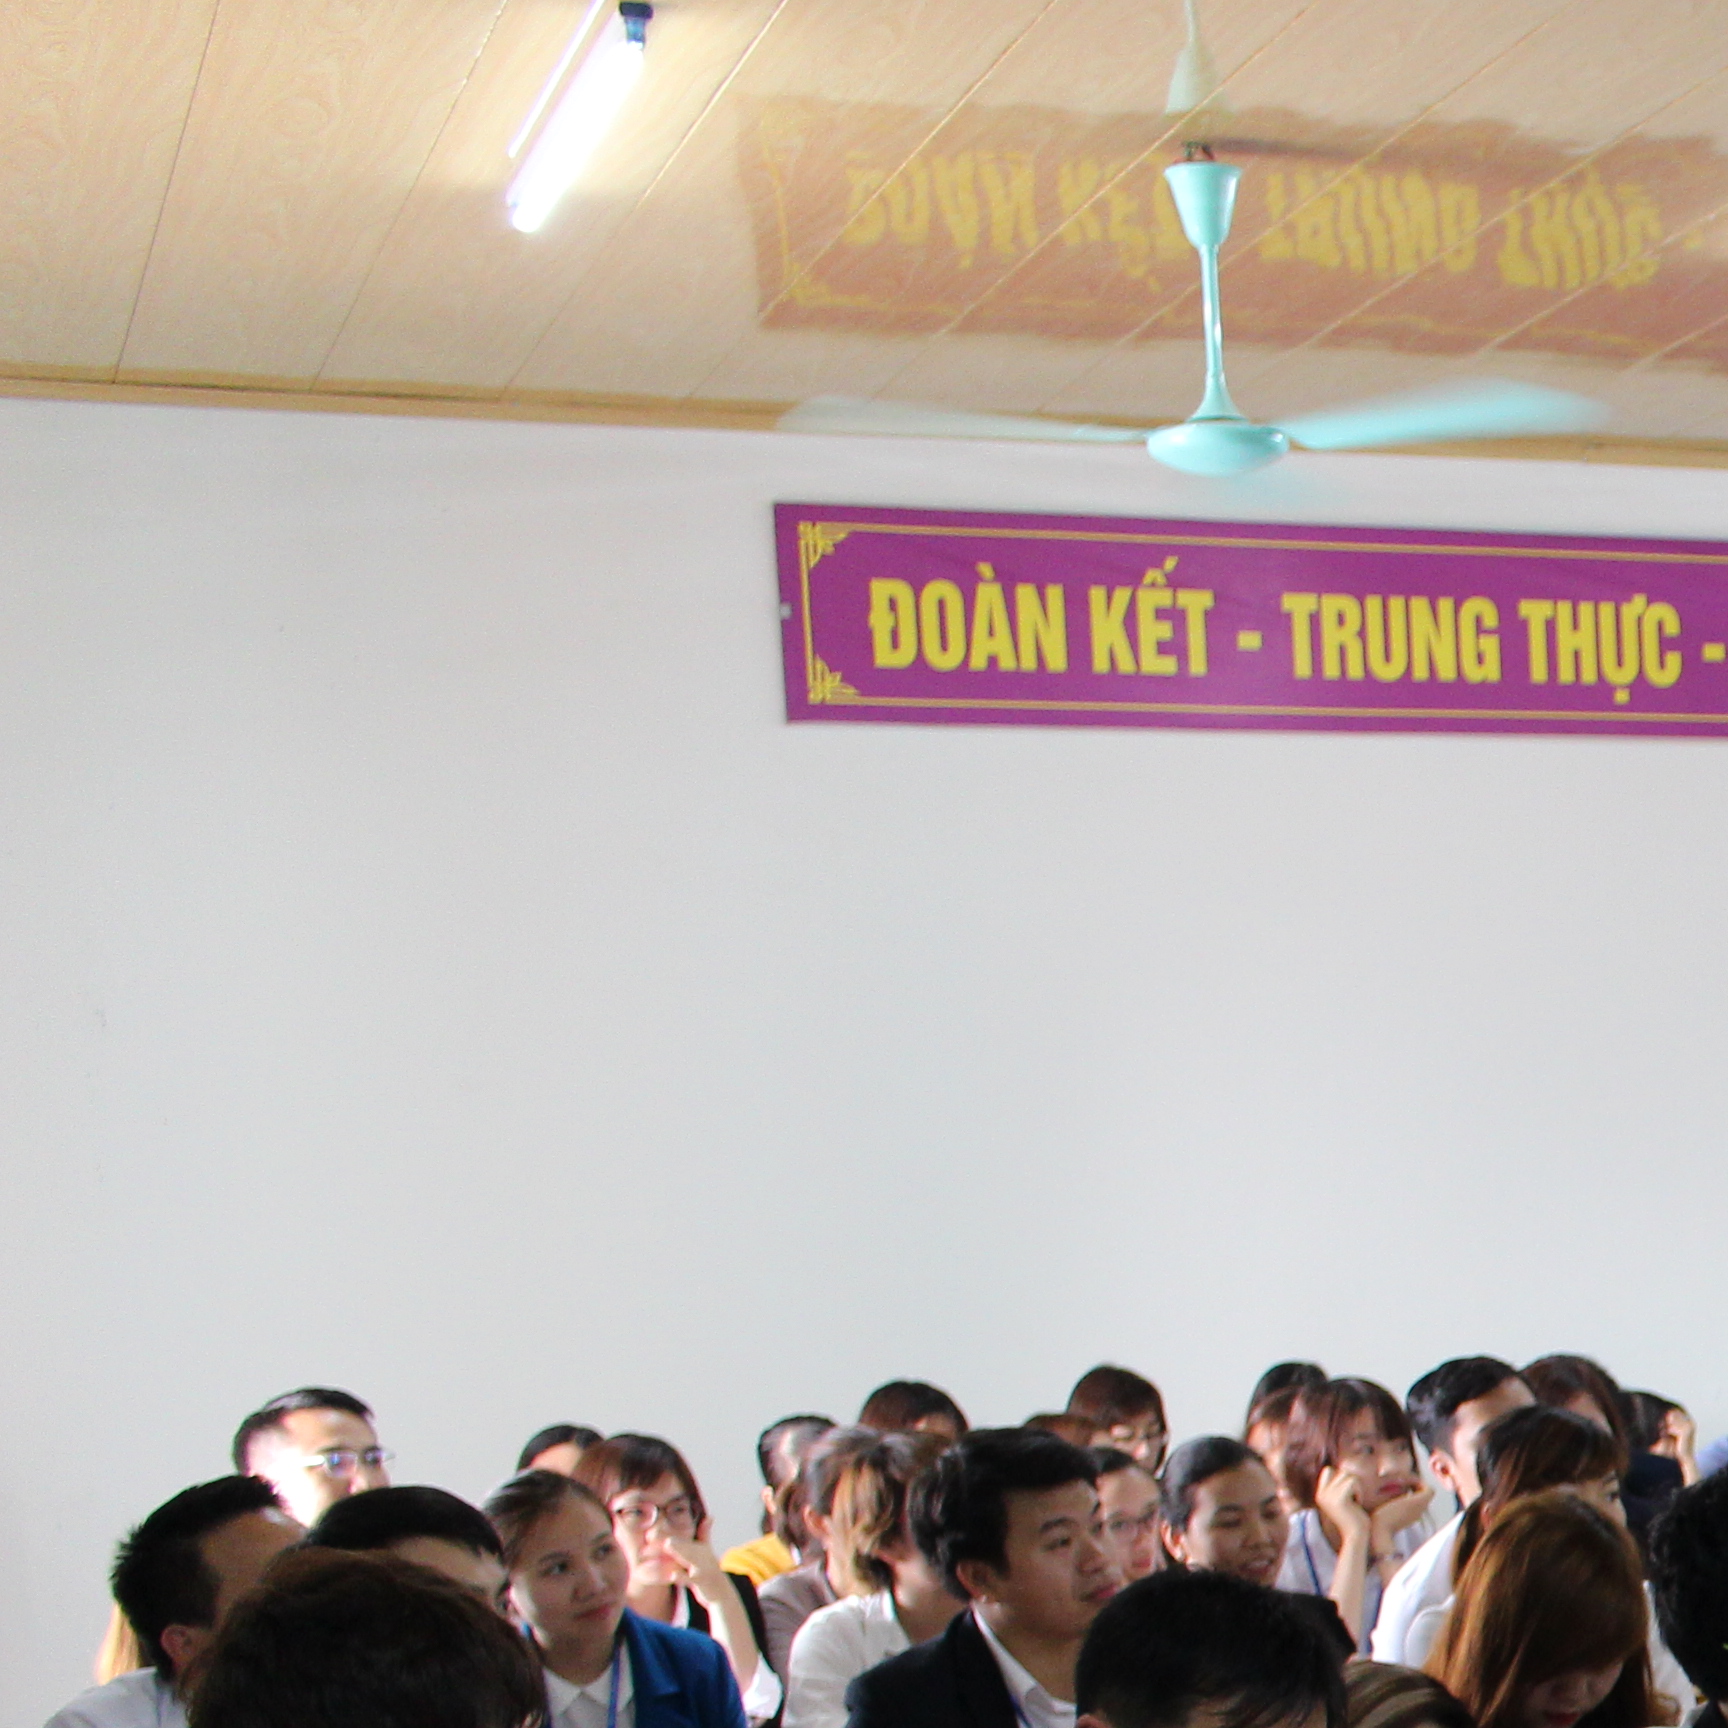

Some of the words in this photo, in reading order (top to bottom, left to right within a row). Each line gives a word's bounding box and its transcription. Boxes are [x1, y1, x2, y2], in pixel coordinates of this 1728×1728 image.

[868, 562, 1067, 673] ĐOÀN
[1088, 556, 1215, 676] KẾT
[1282, 592, 1502, 684] TRUNG
[1517, 593, 1683, 704] THỰC
